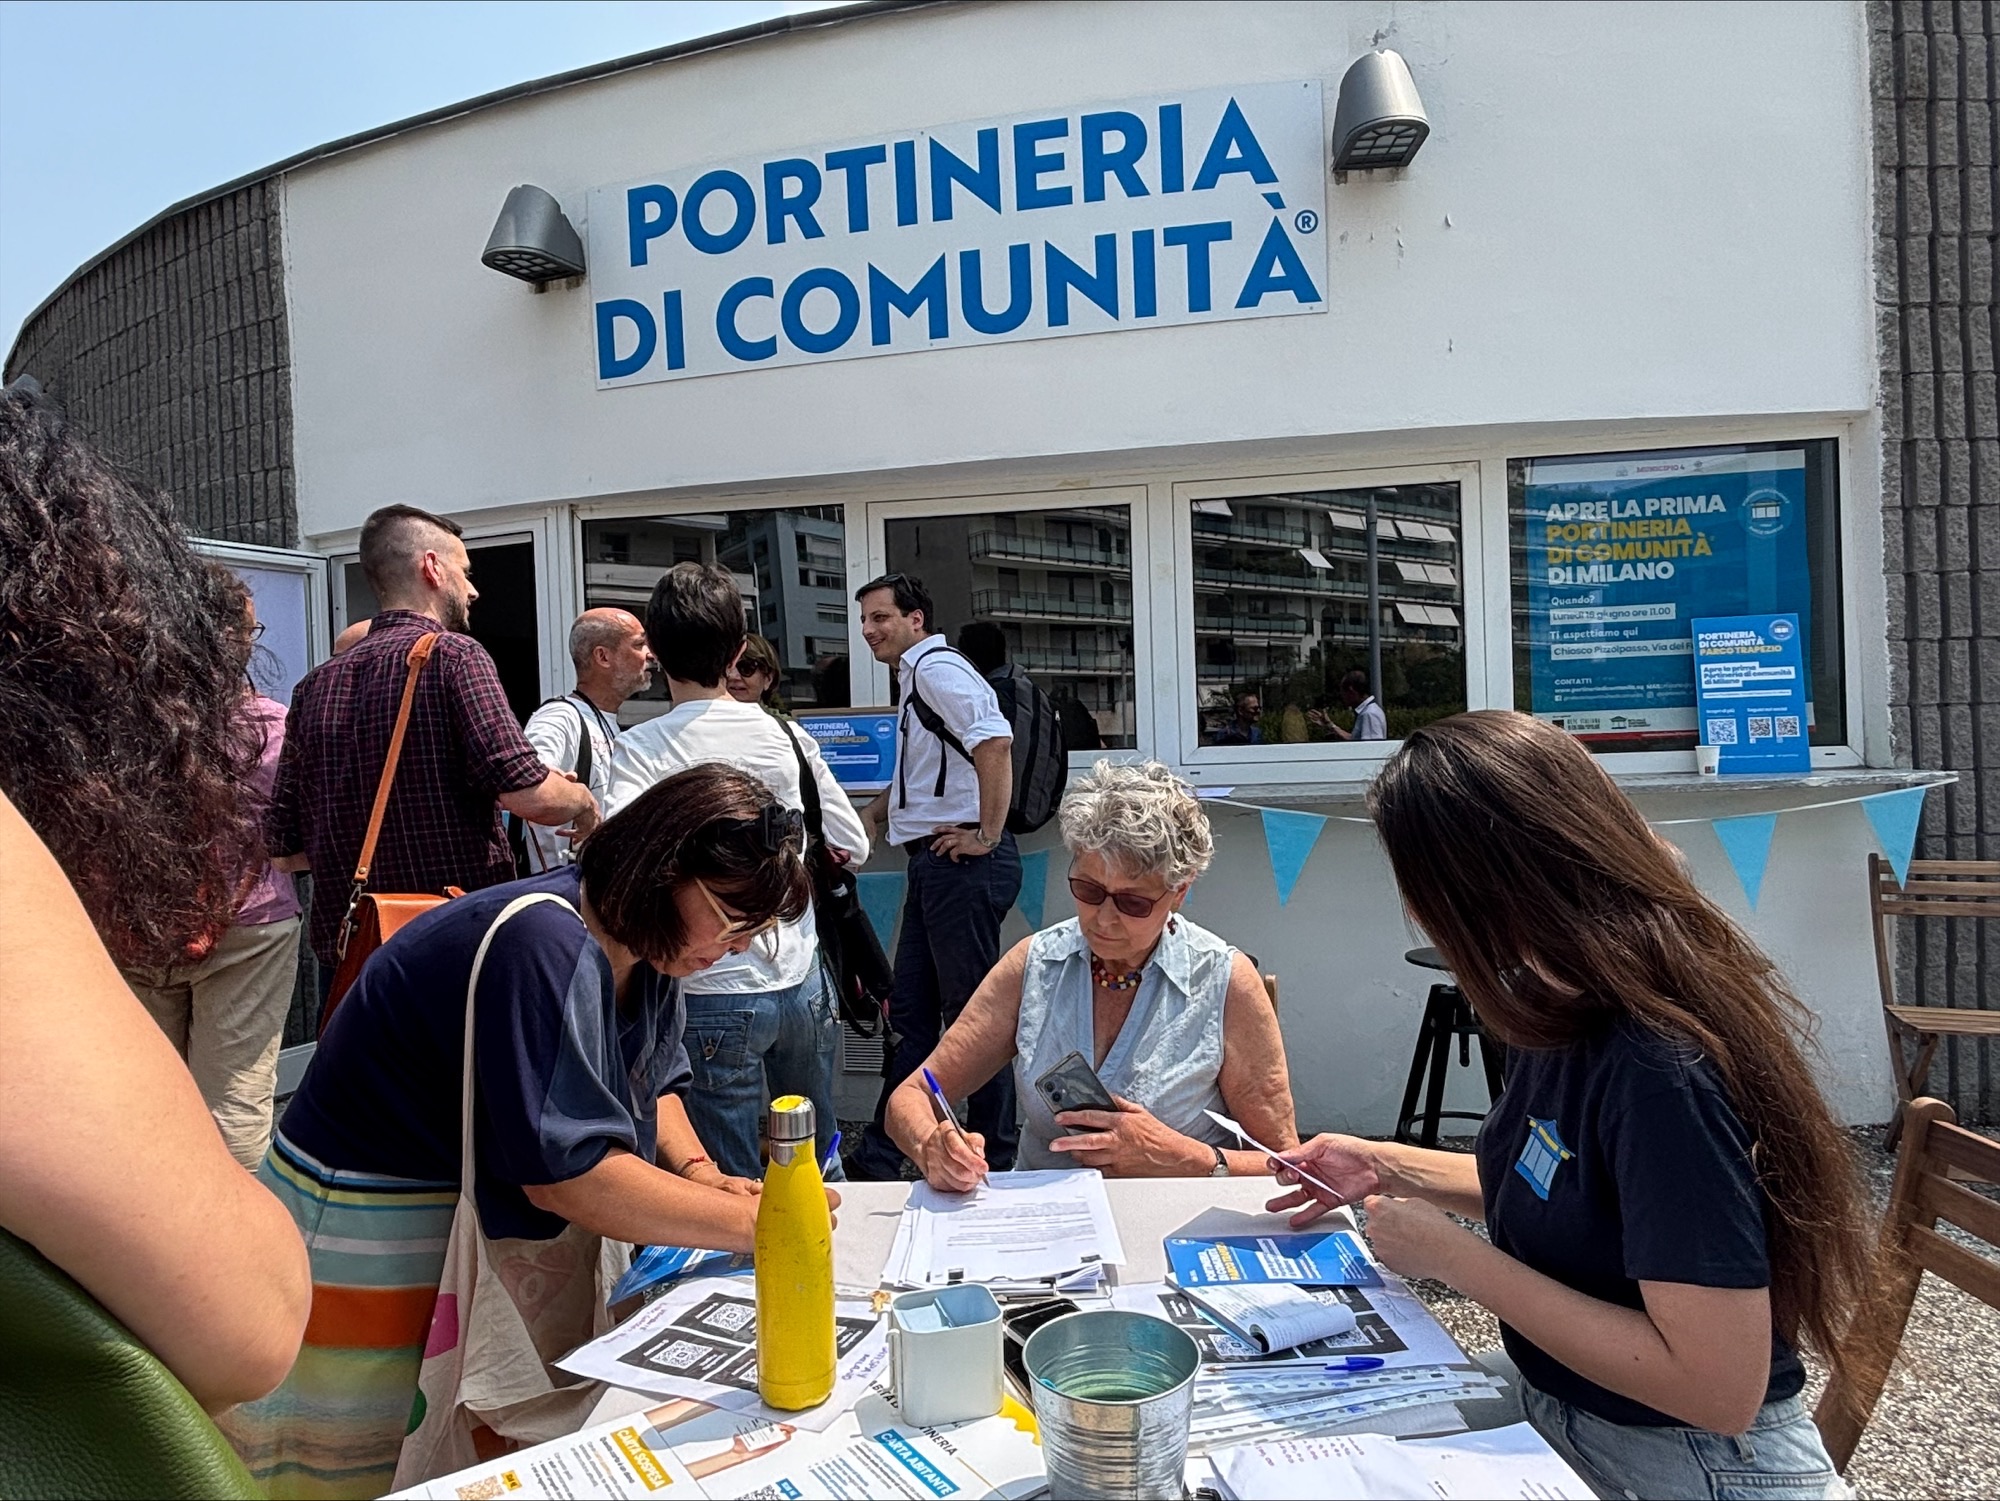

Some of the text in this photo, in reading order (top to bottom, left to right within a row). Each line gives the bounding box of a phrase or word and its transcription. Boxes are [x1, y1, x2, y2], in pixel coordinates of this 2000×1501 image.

[627, 96, 1279, 267] PORTINERIA
[596, 289, 686, 380] DI
[1546, 501, 1609, 522] APRE
[1611, 499, 1642, 518] LA
[1645, 494, 1727, 517] PRIMA
[1547, 517, 1693, 543] PORTINERIA
[1547, 532, 1713, 564] DI COMUNITÀ
[1548, 561, 1675, 585] DI MILANO
[1551, 595, 1595, 606] Quando?
[1596, 609, 1630, 621] giugno
[1633, 609, 1648, 617] ore
[1650, 607, 1671, 616] 11.00
[1550, 627, 1639, 641] Ti aspettiamo qui
[1698, 630, 1756, 641] PORTINERIA
[1710, 635, 1765, 647] COMUNITÀ
[1554, 646, 1592, 656] Chiosco
[1652, 643, 1668, 651] Via
[1700, 645, 1783, 656] PARCO TRAPEZIO
[1554, 677, 1593, 686] CONTATTI
[803, 722, 850, 731] PORTINERIA
[812, 727, 856, 737] COMUNITÀ
[617, 1429, 667, 1488] CARTA SOSPESA
[881, 1432, 912, 1460] CARTA
[906, 1457, 953, 1495] ABITANTE
